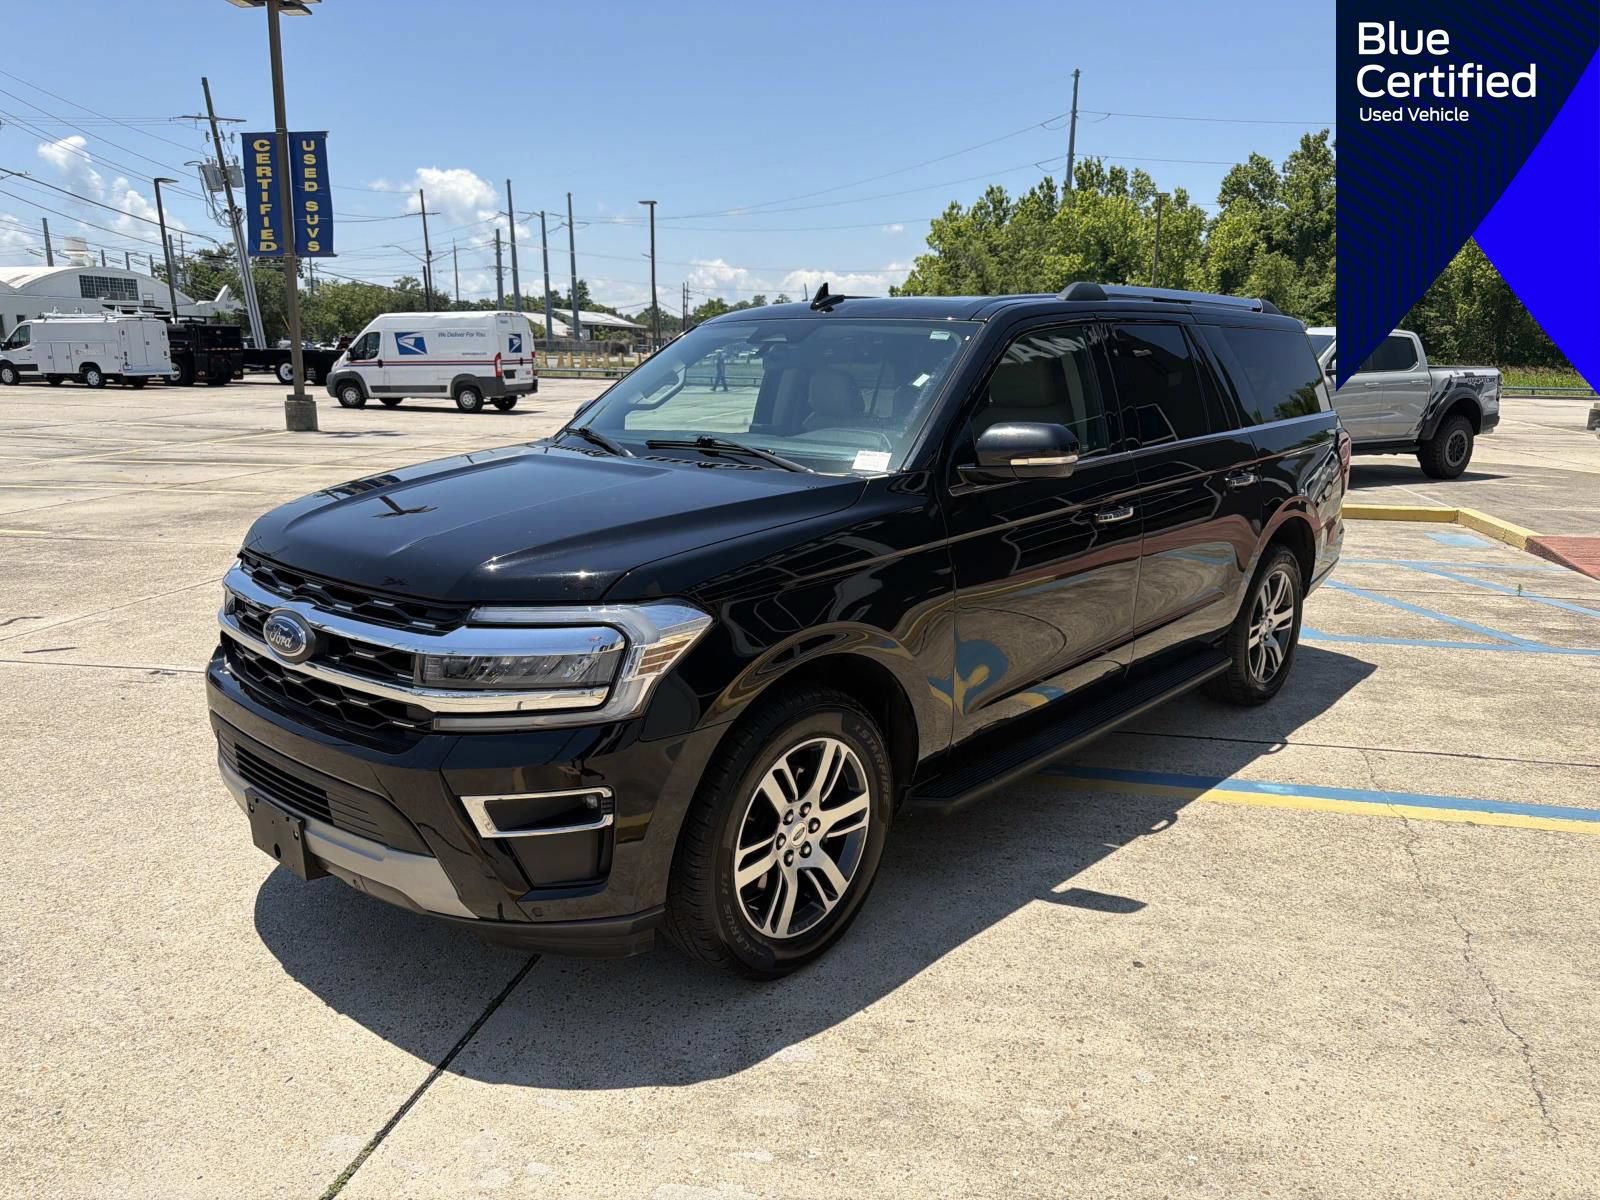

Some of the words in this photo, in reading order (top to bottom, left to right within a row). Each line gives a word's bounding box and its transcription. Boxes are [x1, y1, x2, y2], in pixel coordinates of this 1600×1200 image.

[302, 140, 318, 192] USED
[252, 139, 278, 252] CERTIFIED
[305, 200, 321, 252] SUVS
[269, 623, 294, 649] Ford
